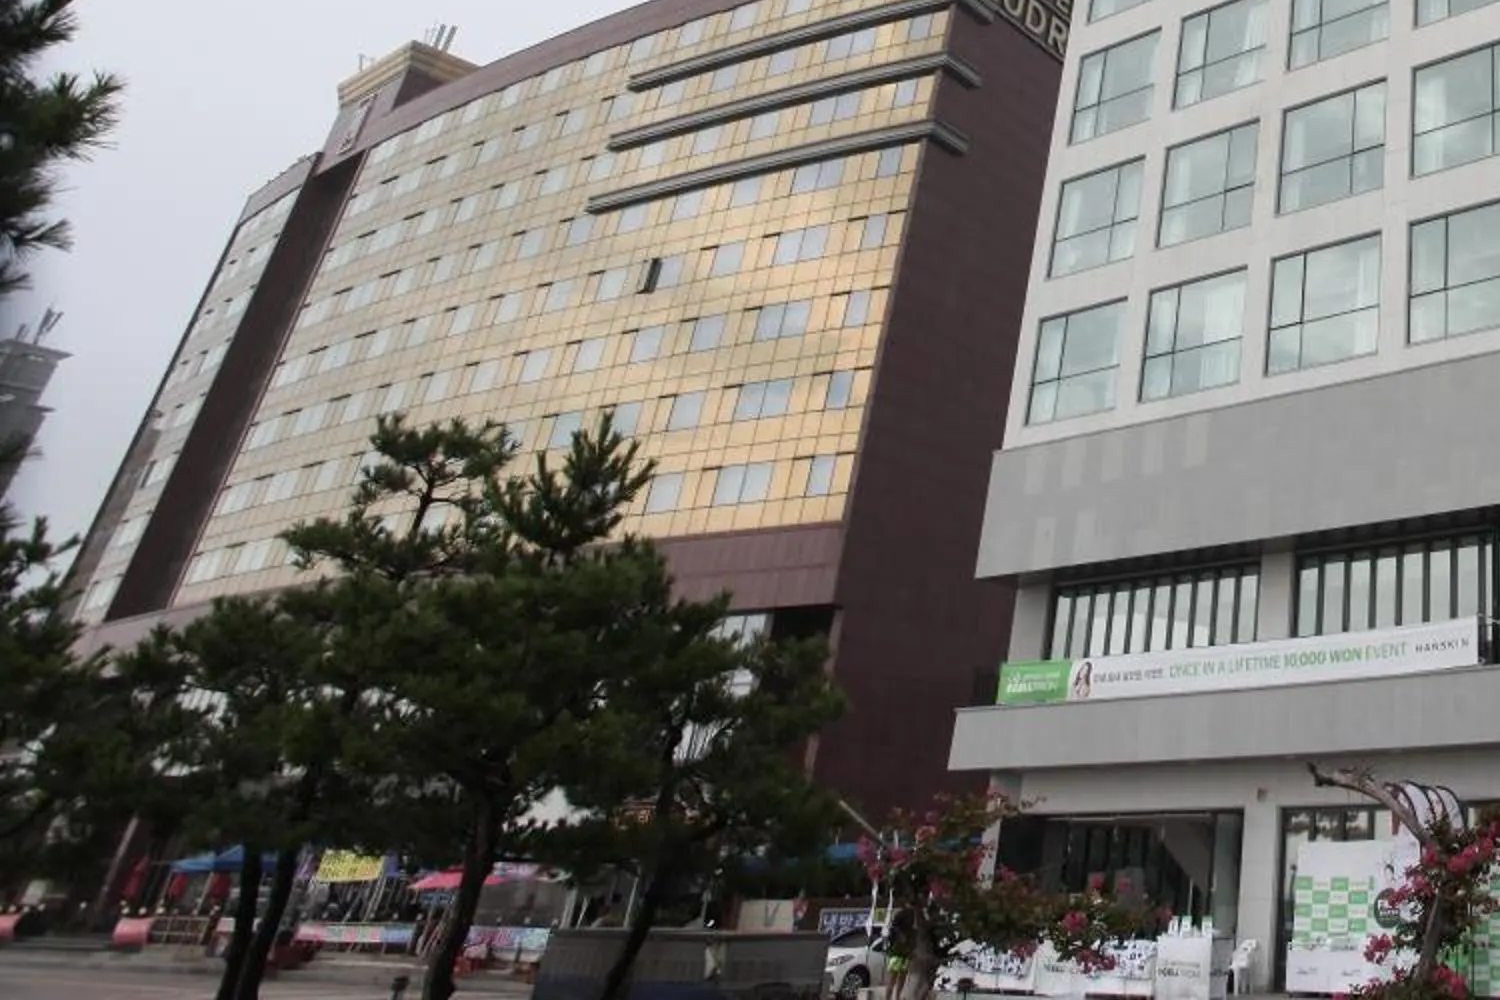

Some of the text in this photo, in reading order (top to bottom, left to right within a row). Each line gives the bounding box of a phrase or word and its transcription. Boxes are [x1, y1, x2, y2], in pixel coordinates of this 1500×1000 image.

[1228, 655, 1281, 674] LIFETIME
[1284, 650, 1327, 668] 10,000
[1329, 646, 1361, 665] WON
[1365, 641, 1406, 662] EVENT
[1415, 638, 1470, 653] HANSKIN
